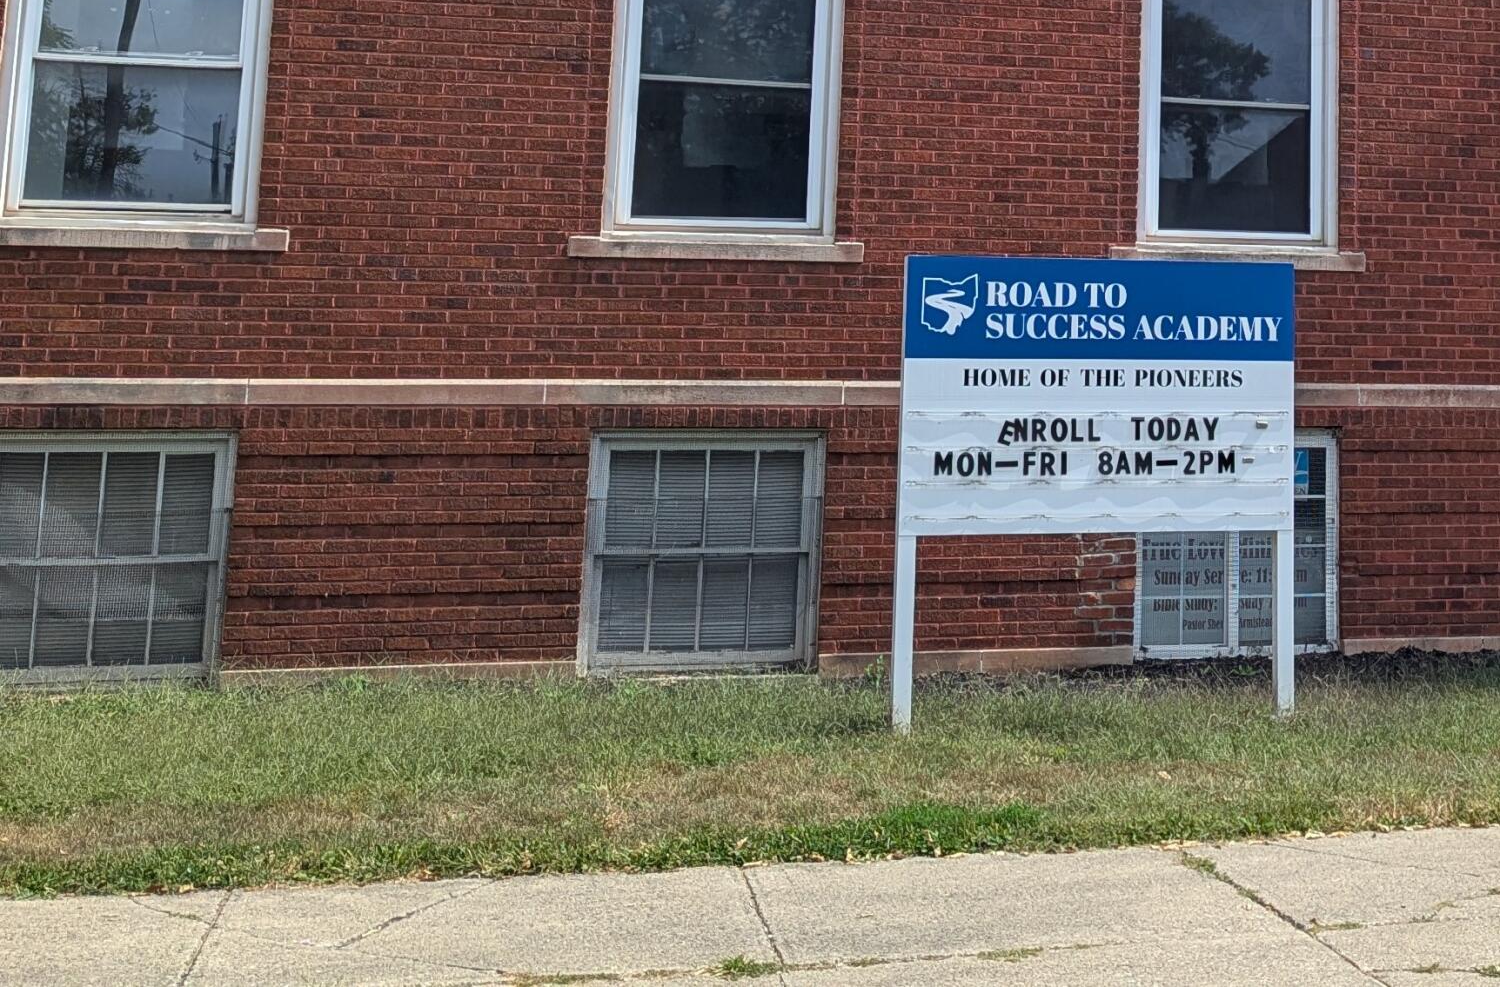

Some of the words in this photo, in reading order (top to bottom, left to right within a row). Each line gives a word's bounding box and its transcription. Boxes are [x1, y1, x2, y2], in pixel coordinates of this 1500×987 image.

[986, 281, 1077, 308] ROAD
[1084, 283, 1127, 309] TO
[985, 314, 1126, 340] SUCCESS
[1133, 315, 1283, 342] ACADEMY
[963, 368, 1031, 387] HOME
[1040, 369, 1070, 387] OF
[1080, 369, 1126, 388] THE
[1134, 369, 1243, 388] PIONEERS
[998, 418, 1100, 446] ENROLL
[1131, 417, 1220, 442] TODAY
